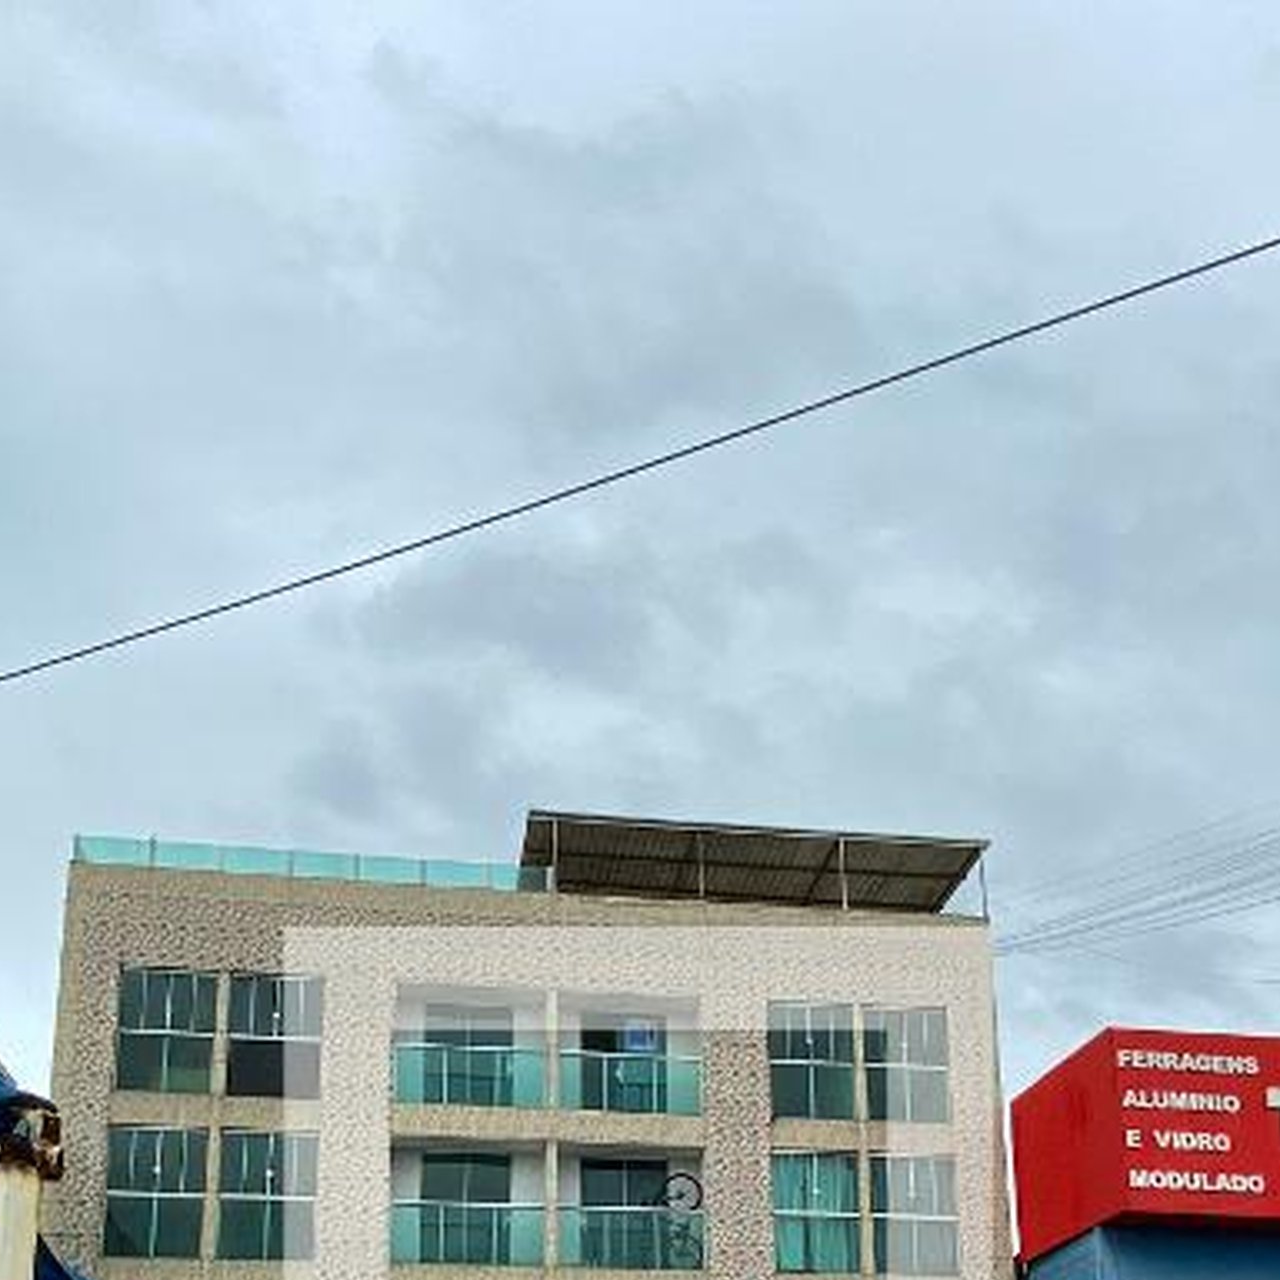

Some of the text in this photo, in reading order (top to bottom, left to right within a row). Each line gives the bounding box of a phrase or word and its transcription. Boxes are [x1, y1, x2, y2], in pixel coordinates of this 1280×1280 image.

[1117, 1050, 1260, 1074] FERRAGENS
[1123, 1089, 1241, 1113] ALUMINIO
[1126, 1129, 1231, 1151] E VIDRO
[1129, 1169, 1265, 1193] MODULADO
